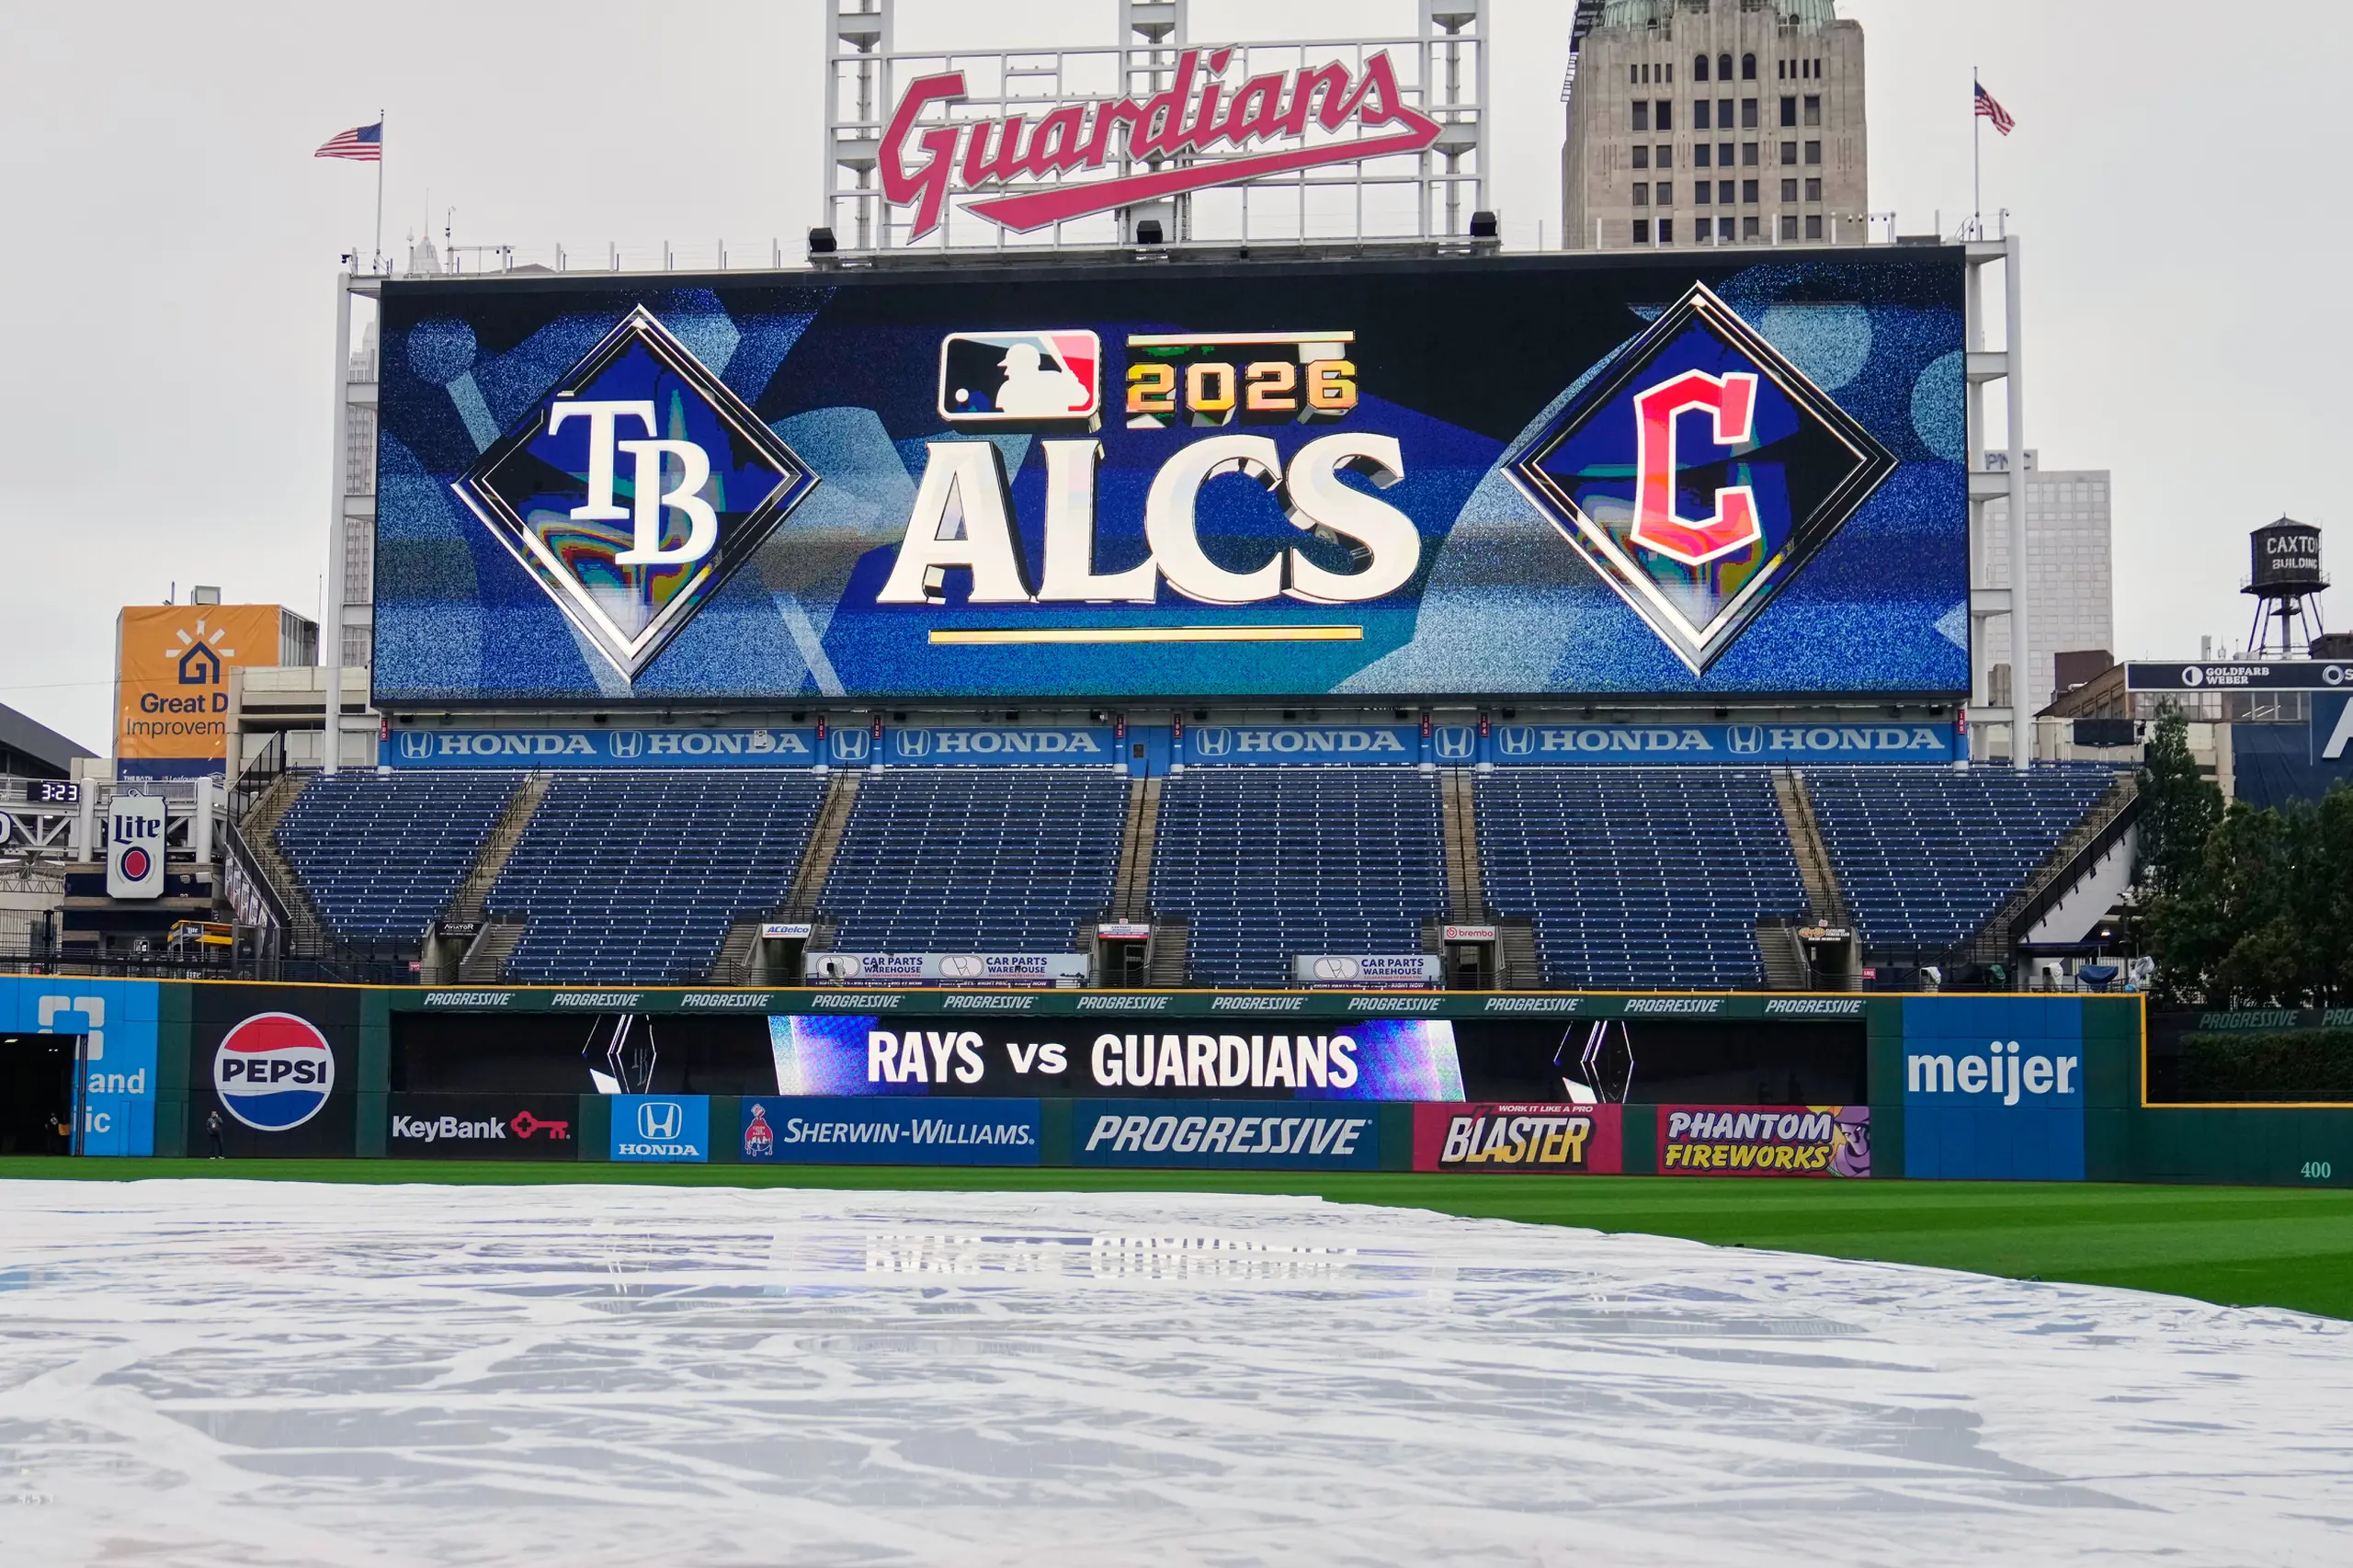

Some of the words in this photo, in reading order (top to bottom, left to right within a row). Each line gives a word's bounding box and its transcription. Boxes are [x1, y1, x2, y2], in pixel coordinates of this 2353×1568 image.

[877, 43, 1445, 244] Guardians
[1127, 359, 1358, 413] 2026
[1631, 369, 1761, 565] C
[548, 400, 718, 564] TB
[876, 432, 1421, 603] ALCS
[2267, 536, 2317, 553] CAXTO
[2272, 558, 2317, 569] BUILDING
[2206, 666, 2270, 676] GOLDFARB
[2206, 676, 2248, 685] WEBER
[140, 692, 206, 713] Great
[127, 717, 225, 739] Improvem
[438, 734, 597, 755] HONDA
[647, 733, 809, 754] HONDA
[936, 733, 1101, 752] HONDA
[1237, 732, 1405, 752] HONDA
[1540, 730, 1713, 750] HONDA
[1769, 729, 1945, 750] HONDA
[42, 785, 78, 801] 3:23
[113, 815, 161, 845] Lite
[1459, 928, 1493, 937] brembo
[863, 957, 885, 965] CAR
[888, 957, 923, 965] PARTS
[986, 957, 1009, 965] CAR
[1012, 957, 1048, 965] PARTS
[1361, 959, 1385, 967] CAR
[1388, 958, 1424, 967] PARTS
[424, 993, 511, 1006] PROGRESSIVE
[551, 994, 641, 1006] PROGRESSIVE
[681, 994, 770, 1007] PROGRESSIVE
[812, 994, 901, 1007] PROGRESSIVE
[943, 995, 1034, 1008] PROGRESSIVE
[1076, 996, 1169, 1009] PROGRESSIVE
[1211, 996, 1304, 1010] PROGRESSIVE
[1347, 997, 1441, 1010] PROGRESSIVE
[1484, 998, 1579, 1011] PROGRESSIVE
[1624, 999, 1720, 1013] PROGRESSIVE
[1765, 1000, 1861, 1013] PROGRESSIVE
[2199, 1010, 2298, 1029] PROGRESSIVE
[868, 1031, 984, 1084] RAYS
[1092, 1034, 1358, 1088] GUARDIANS
[222, 1058, 326, 1084] PEPSI
[1908, 1040, 2077, 1106] meijer
[88, 1068, 145, 1094] and
[392, 1115, 506, 1142] KeyBank
[784, 1118, 1030, 1145] SHERWIN-WILLIAMS
[1085, 1115, 1367, 1154] PROGRESSIVE
[1668, 1112, 1833, 1140] PHANTOM
[1441, 1116, 1591, 1163] BLASTER
[619, 1144, 699, 1155] HONDA
[1665, 1144, 1830, 1169] FIREWORKS
[2301, 1162, 2331, 1177] 400
